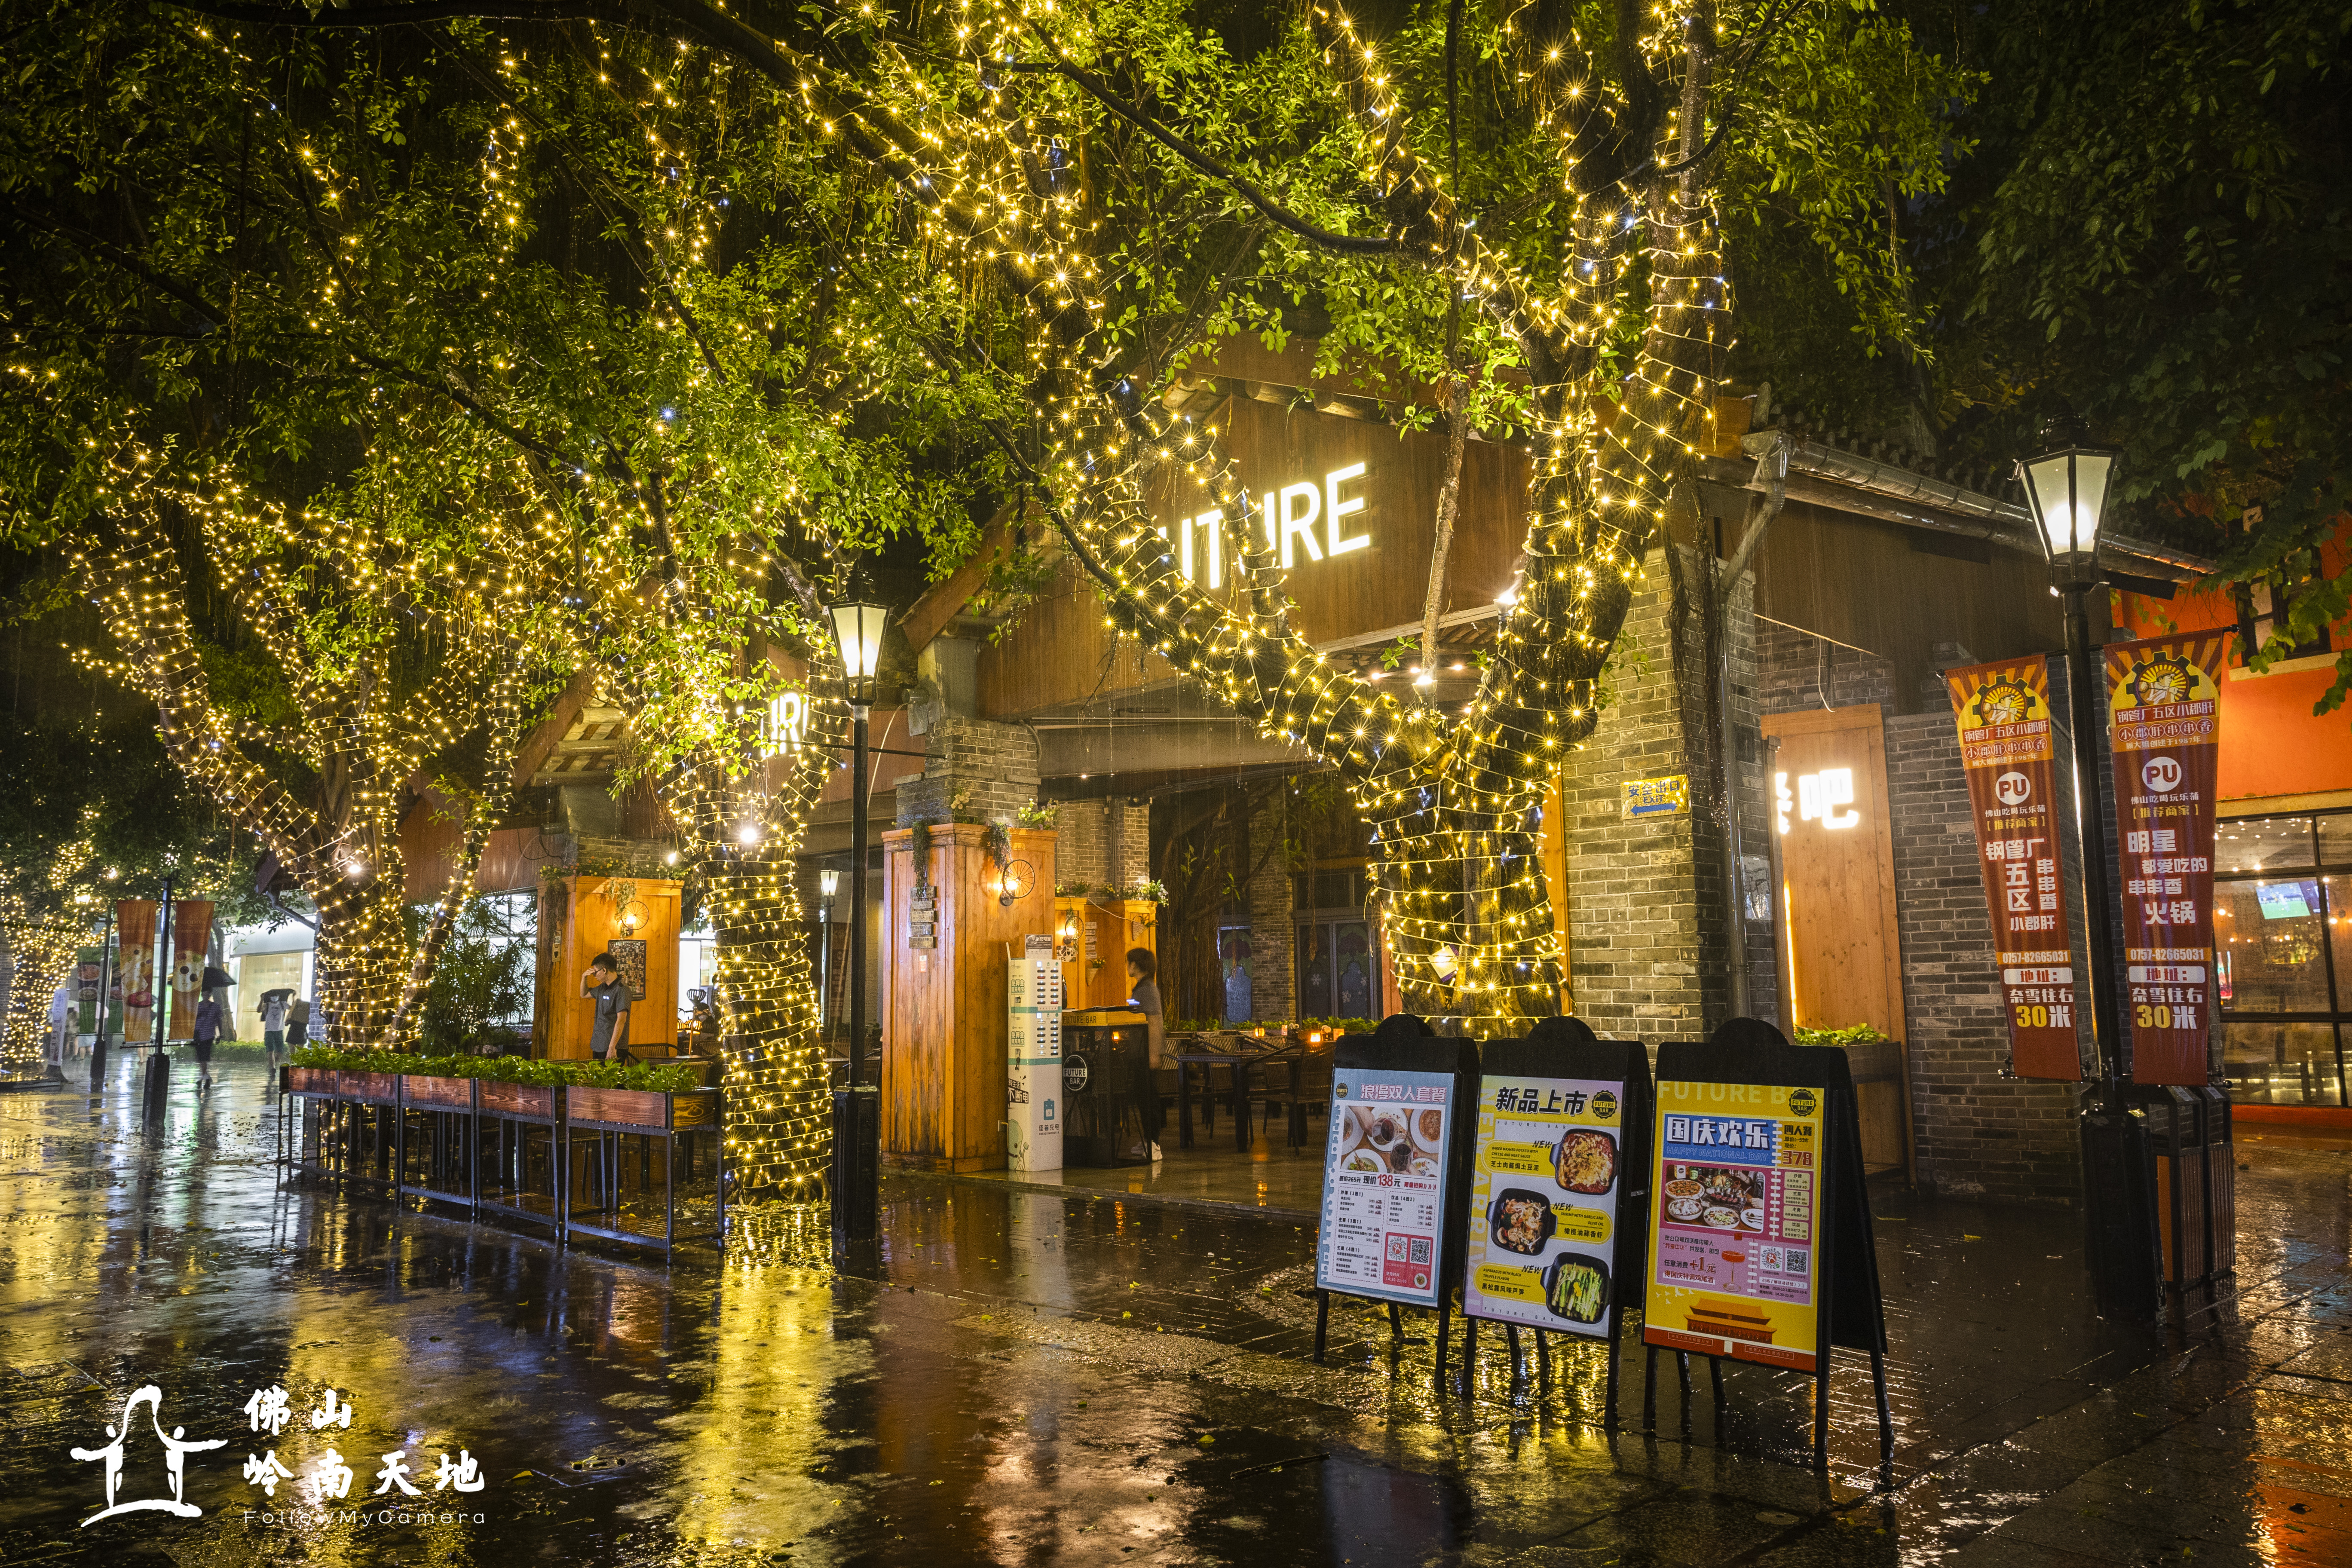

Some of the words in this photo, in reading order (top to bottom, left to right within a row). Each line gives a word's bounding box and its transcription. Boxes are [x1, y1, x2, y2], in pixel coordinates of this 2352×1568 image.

[2116, 700, 2214, 723] 钢管厂五区小郡肝
[1964, 720, 2049, 742] 钢管厂五区小郡肝
[2118, 718, 2213, 741] 小郡肝串串香
[1965, 737, 2048, 760] 小郡肝串串香
[2146, 765, 2177, 784] PU
[1629, 781, 1679, 797] 安全出口
[1999, 780, 2026, 798] PU
[1644, 795, 1663, 803] EXIT
[1985, 838, 2045, 860] 钢管厂
[2127, 830, 2177, 853] 明星
[2142, 857, 2207, 874] 都爱吃的
[2006, 863, 2031, 911] 五区
[2037, 858, 2057, 910] 串串香
[2128, 879, 2182, 895] 串串香
[2145, 901, 2196, 925] 火锅
[2010, 915, 2055, 931] 小郡肝
[2003, 950, 2068, 964] 0757-82665031
[2130, 948, 2204, 961] 0757-82665031
[2020, 970, 2058, 983] 地址：
[2146, 968, 2187, 982] 地址：
[2009, 988, 2073, 1003] 奈雪往右
[2132, 988, 2202, 1003] 奈雪往右
[2015, 1005, 2071, 1028] 30米
[2137, 1005, 2196, 1029] 30米
[1360, 1084, 1447, 1102] 浪漫双人套餐
[1658, 1081, 1762, 1103] FUTURE
[1495, 1086, 1588, 1116] 新品上市
[1667, 1117, 1770, 1150] 国庆欢乐
[1785, 1125, 1812, 1136] 四人餐
[1532, 1140, 1553, 1149] NEW
[1667, 1147, 1697, 1155] HAPPY
[1700, 1149, 1746, 1160] NATIONAL
[1749, 1152, 1768, 1161] DAY
[1782, 1150, 1812, 1166] 378
[1491, 1161, 1539, 1171] 芝士肉酱焗土豆泥
[1553, 1202, 1573, 1211] NEW
[1564, 1227, 1603, 1238] 橄榄油蒜香虾
[1665, 1235, 1713, 1246] 在公众号对话框内输入
[1522, 1265, 1542, 1274] NEW
[1665, 1270, 1714, 1283] 得国庆特调鸡尾酒
[1482, 1283, 1524, 1295] 黑松露风味芦笋
[1484, 1307, 1524, 1317] FUTURE
